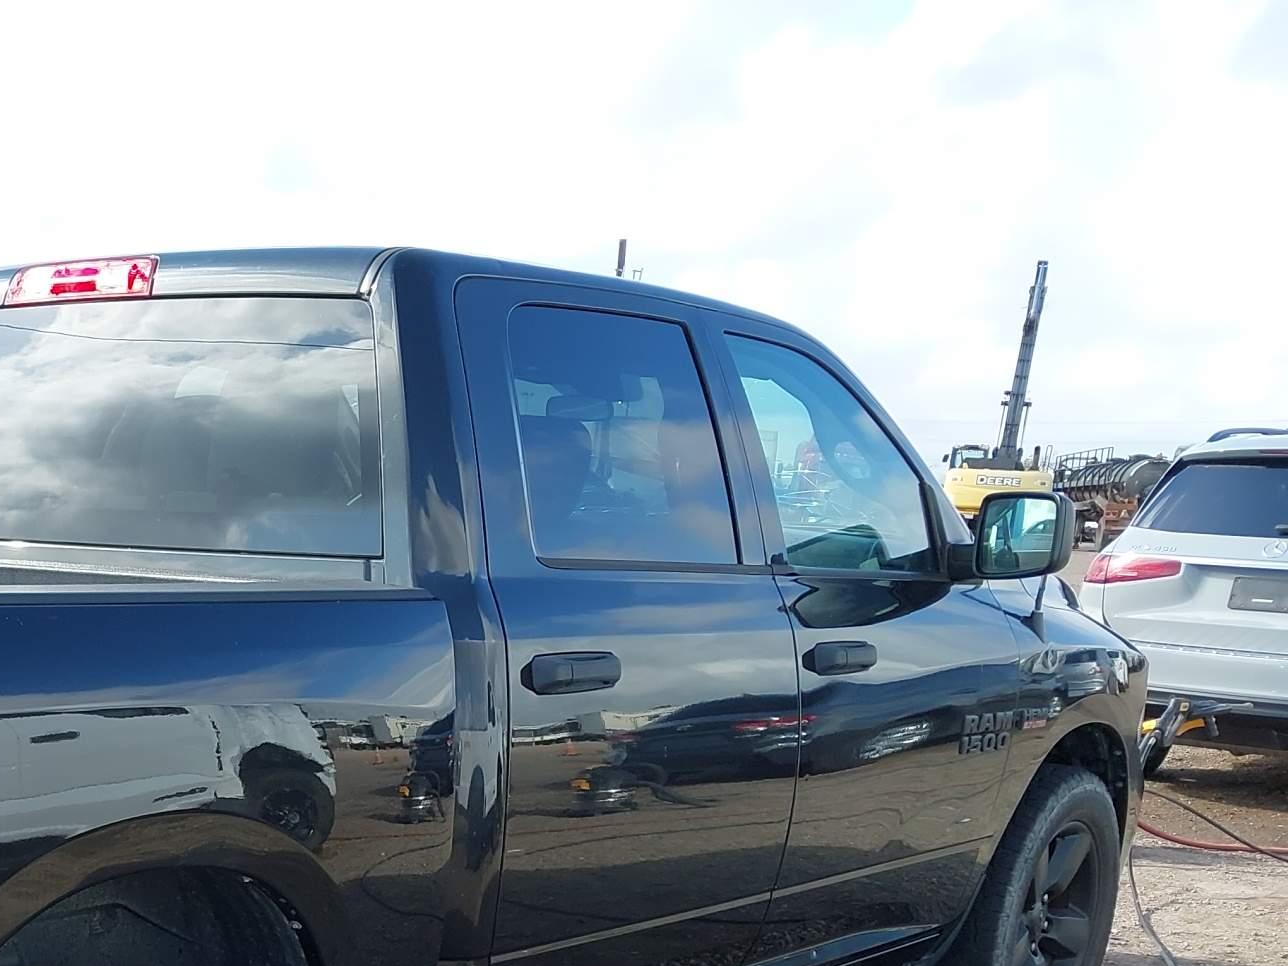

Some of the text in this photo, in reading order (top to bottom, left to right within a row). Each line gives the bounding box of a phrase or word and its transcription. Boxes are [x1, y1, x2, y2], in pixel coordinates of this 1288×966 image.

[976, 475, 1022, 487] DEERE
[963, 710, 1012, 734] RAM
[959, 732, 1010, 753] 1500
